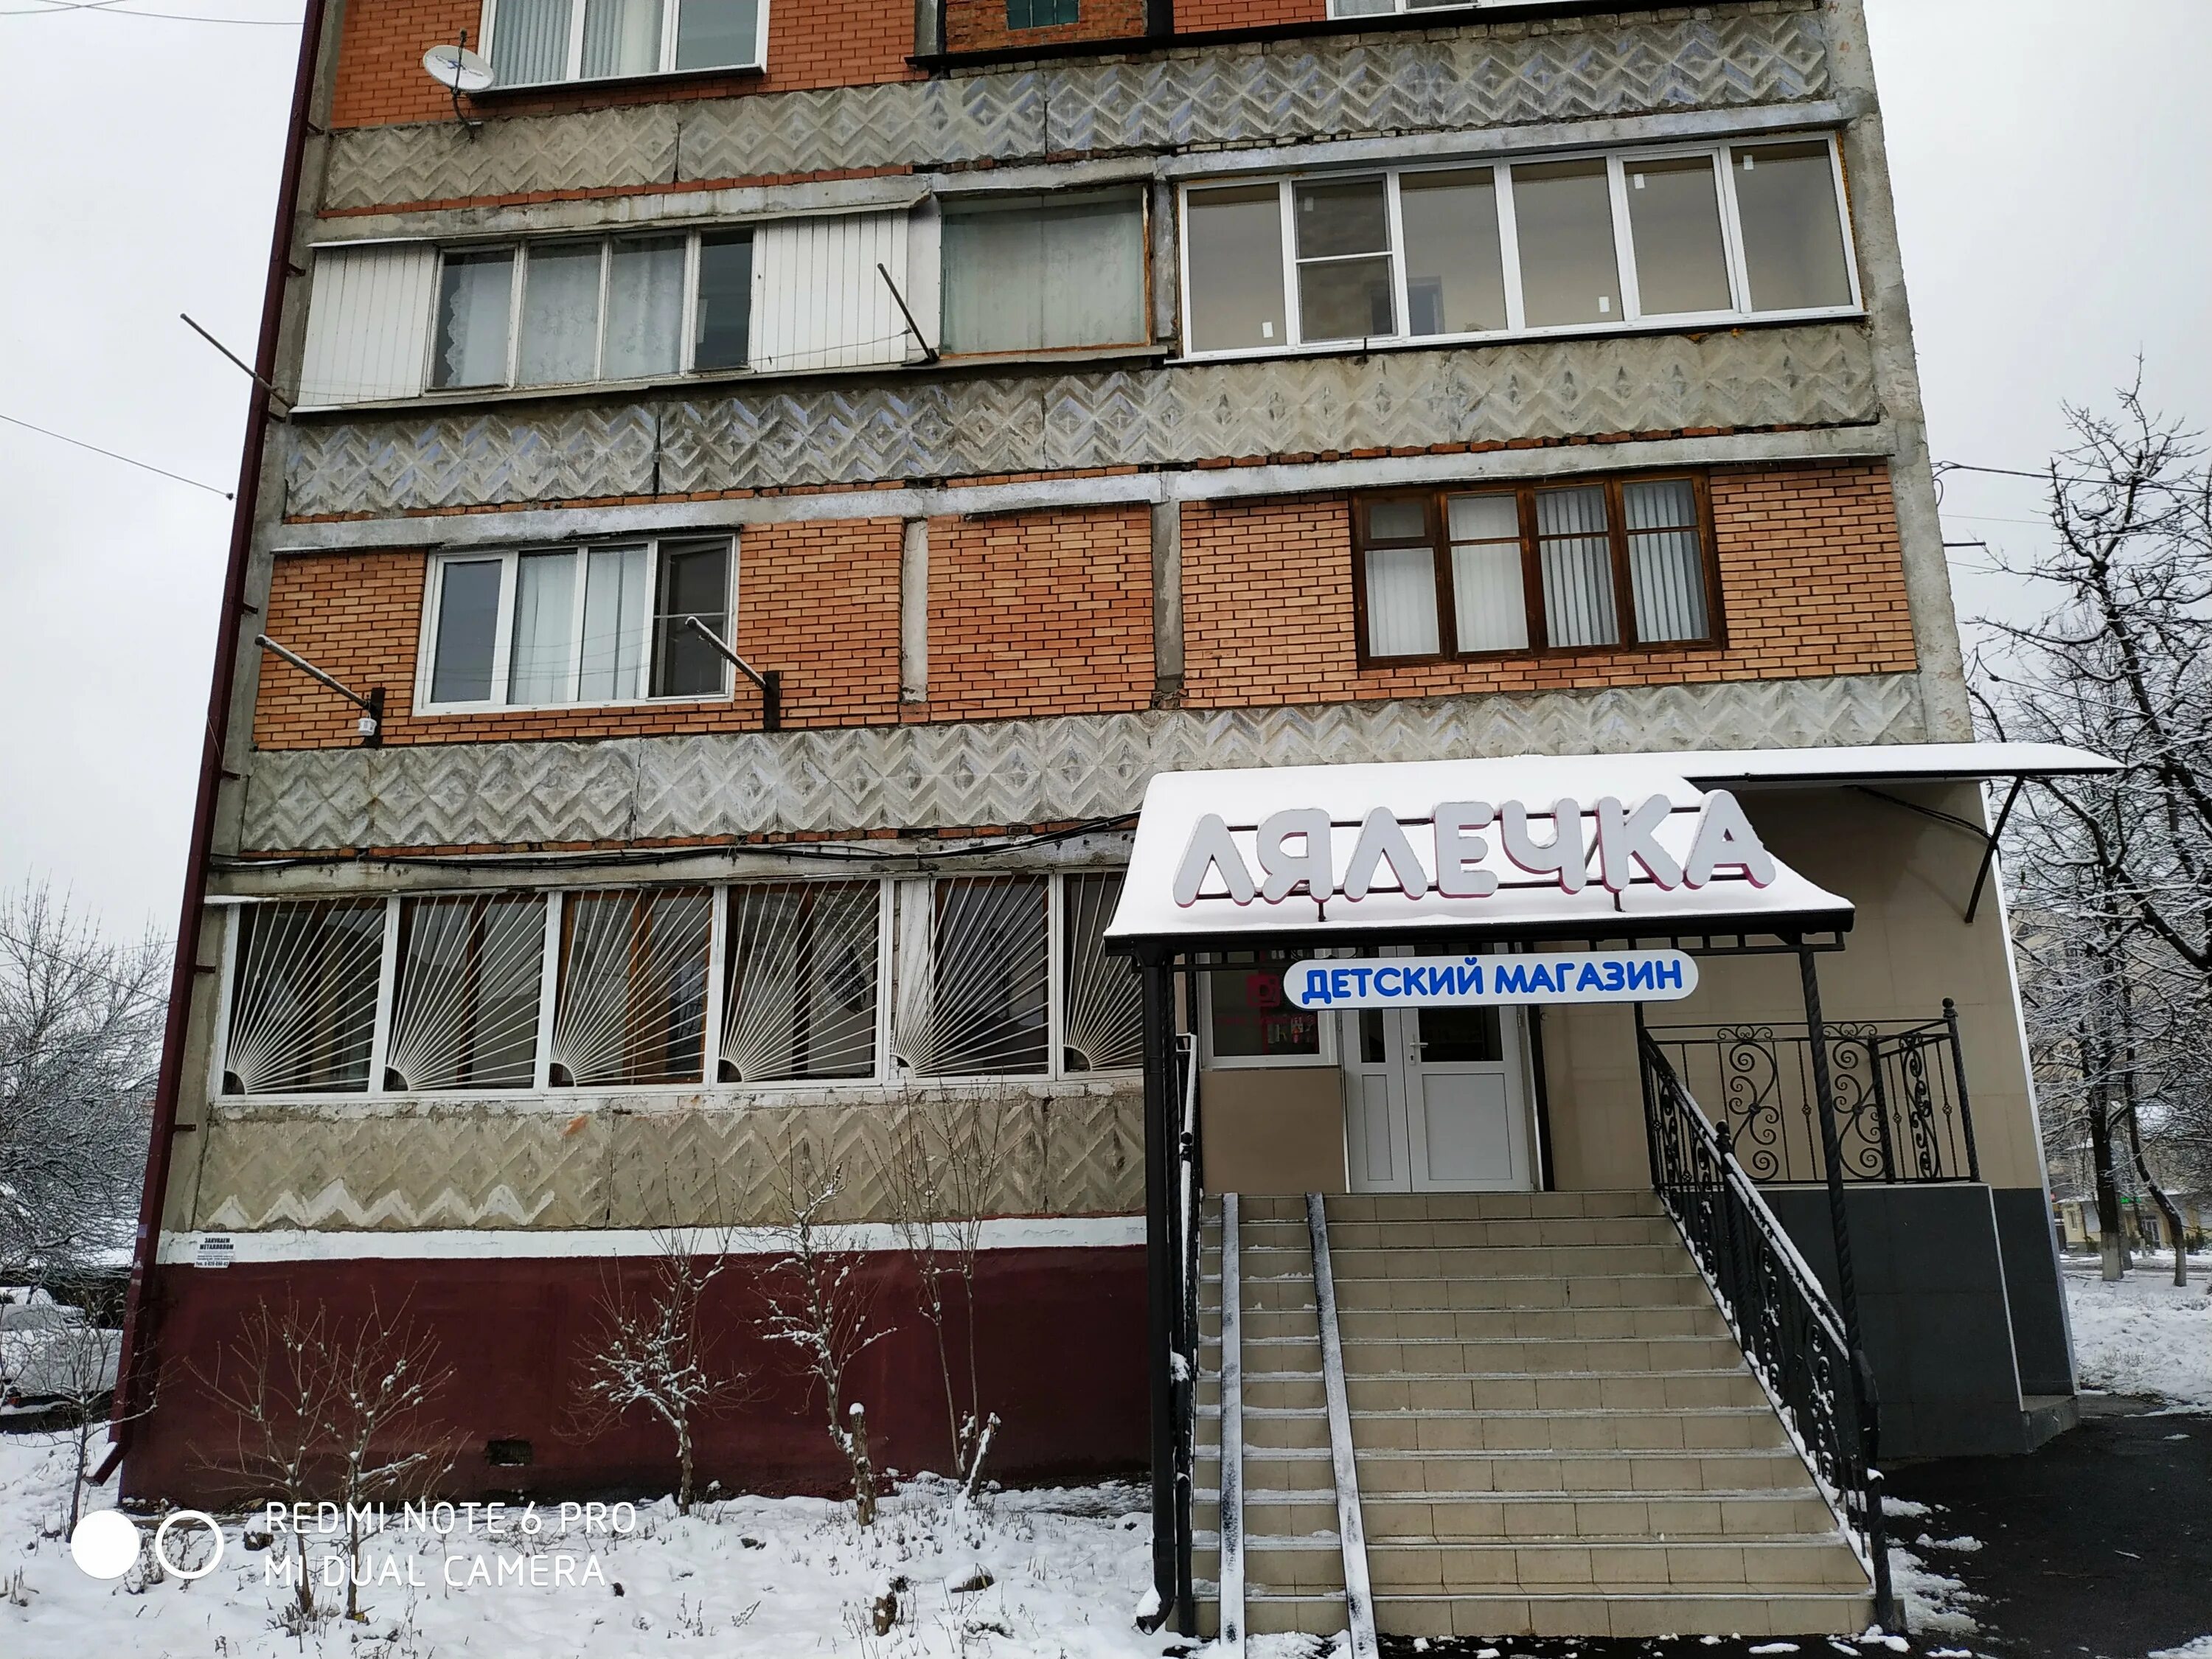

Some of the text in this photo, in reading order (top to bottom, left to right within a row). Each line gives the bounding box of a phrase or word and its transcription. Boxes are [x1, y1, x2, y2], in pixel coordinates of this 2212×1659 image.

[1173, 789, 1776, 908] ЛЯЛЕЧКА
[1301, 957, 1683, 1005] ДЕТСКИЙ МАГАЗИН
